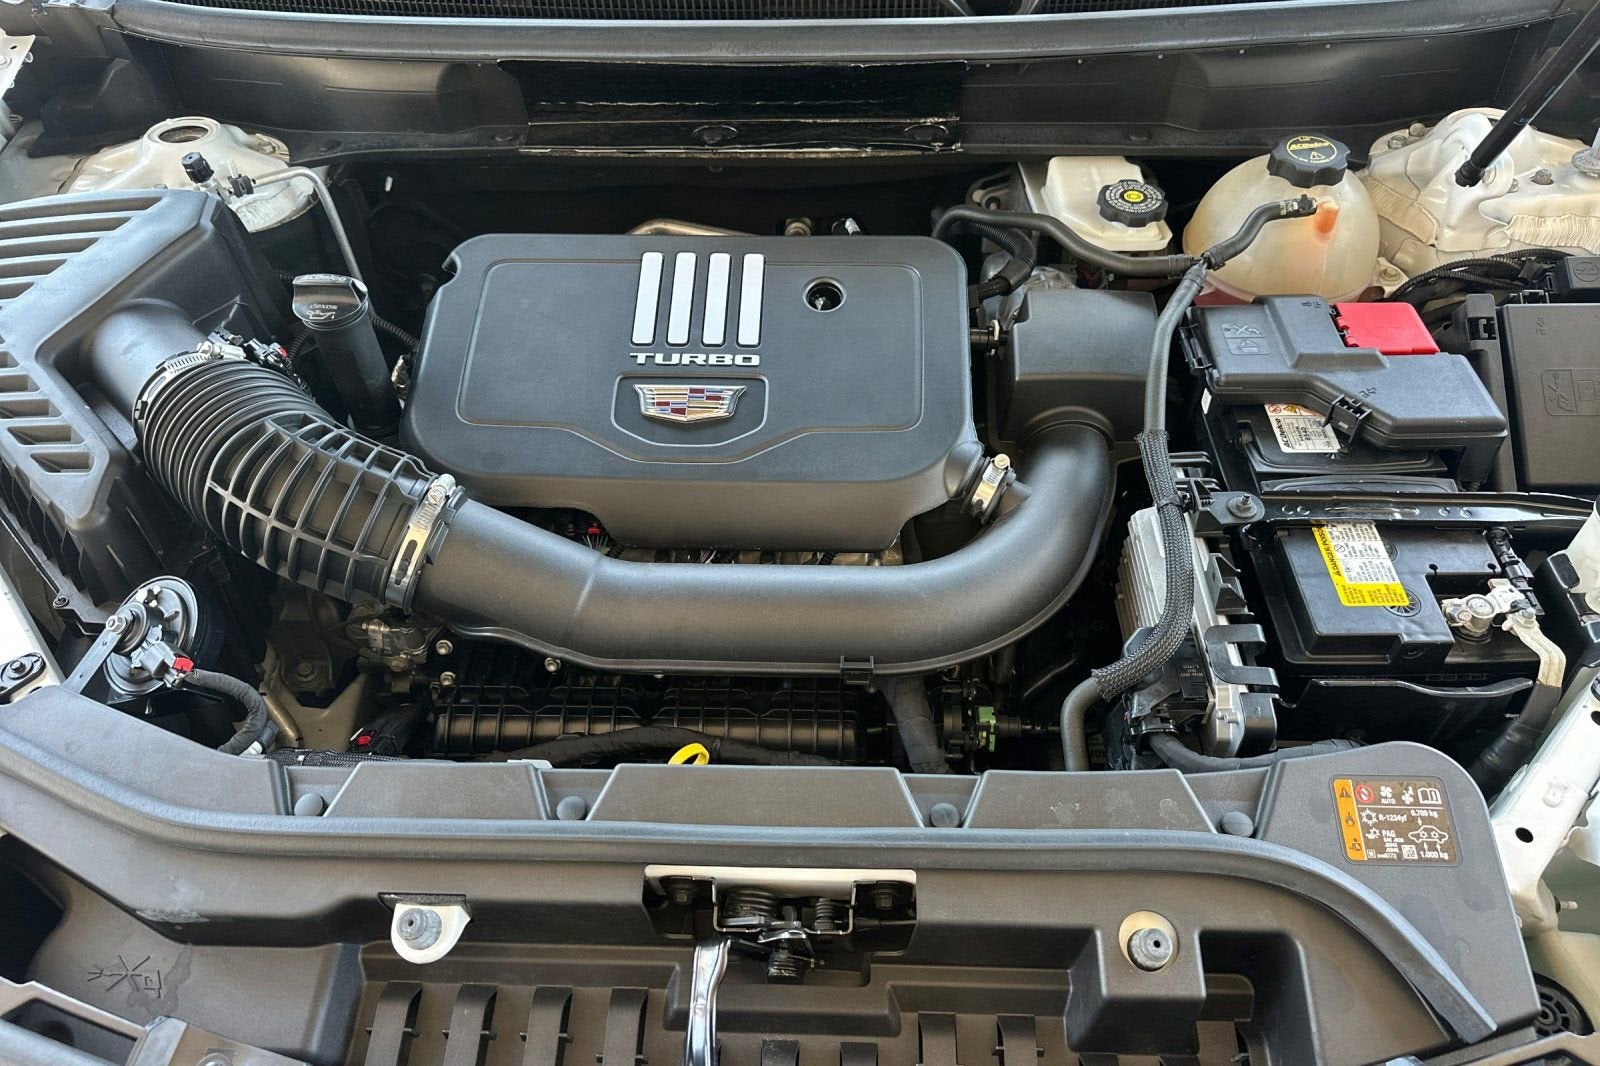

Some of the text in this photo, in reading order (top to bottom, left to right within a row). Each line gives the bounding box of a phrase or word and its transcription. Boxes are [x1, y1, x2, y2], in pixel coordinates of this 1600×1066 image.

[629, 353, 760, 366] TURBO
[1275, 418, 1292, 449] ACDelco
[1378, 814, 1408, 823] R-1234yf
[1381, 830, 1396, 838] PAG
[1439, 852, 1449, 860] kg
